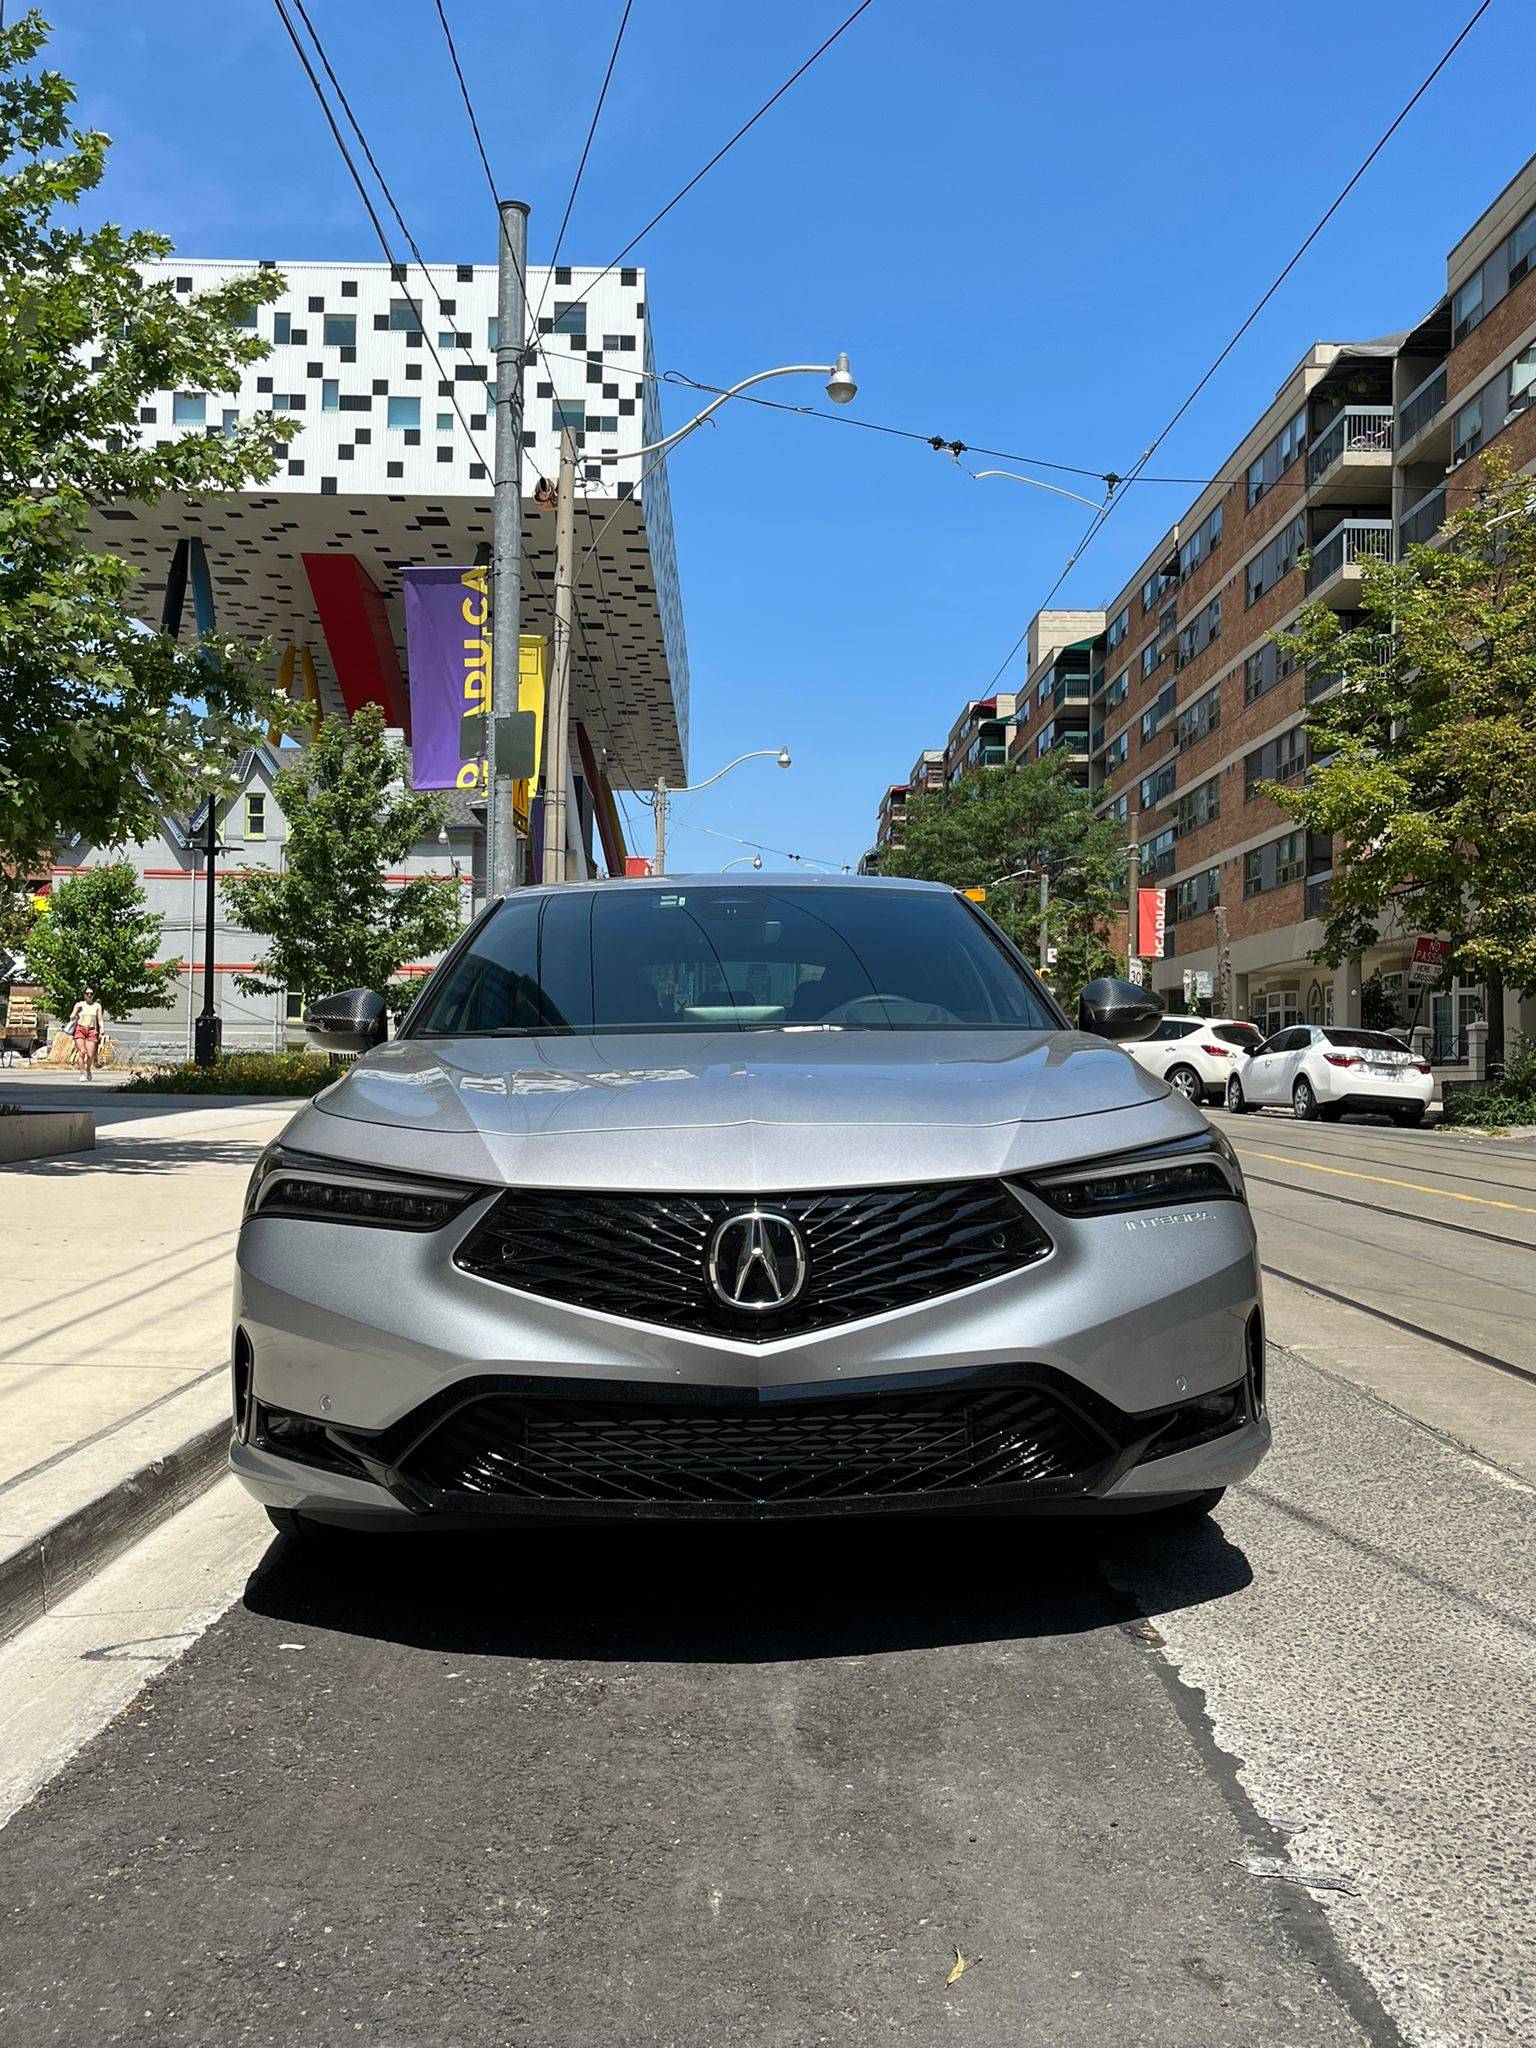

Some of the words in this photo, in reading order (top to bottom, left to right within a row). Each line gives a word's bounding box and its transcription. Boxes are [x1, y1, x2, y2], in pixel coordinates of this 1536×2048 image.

[1429, 941, 1440, 952] NO
[1416, 950, 1443, 963] PASSIN
[1131, 970, 1142, 985] 30
